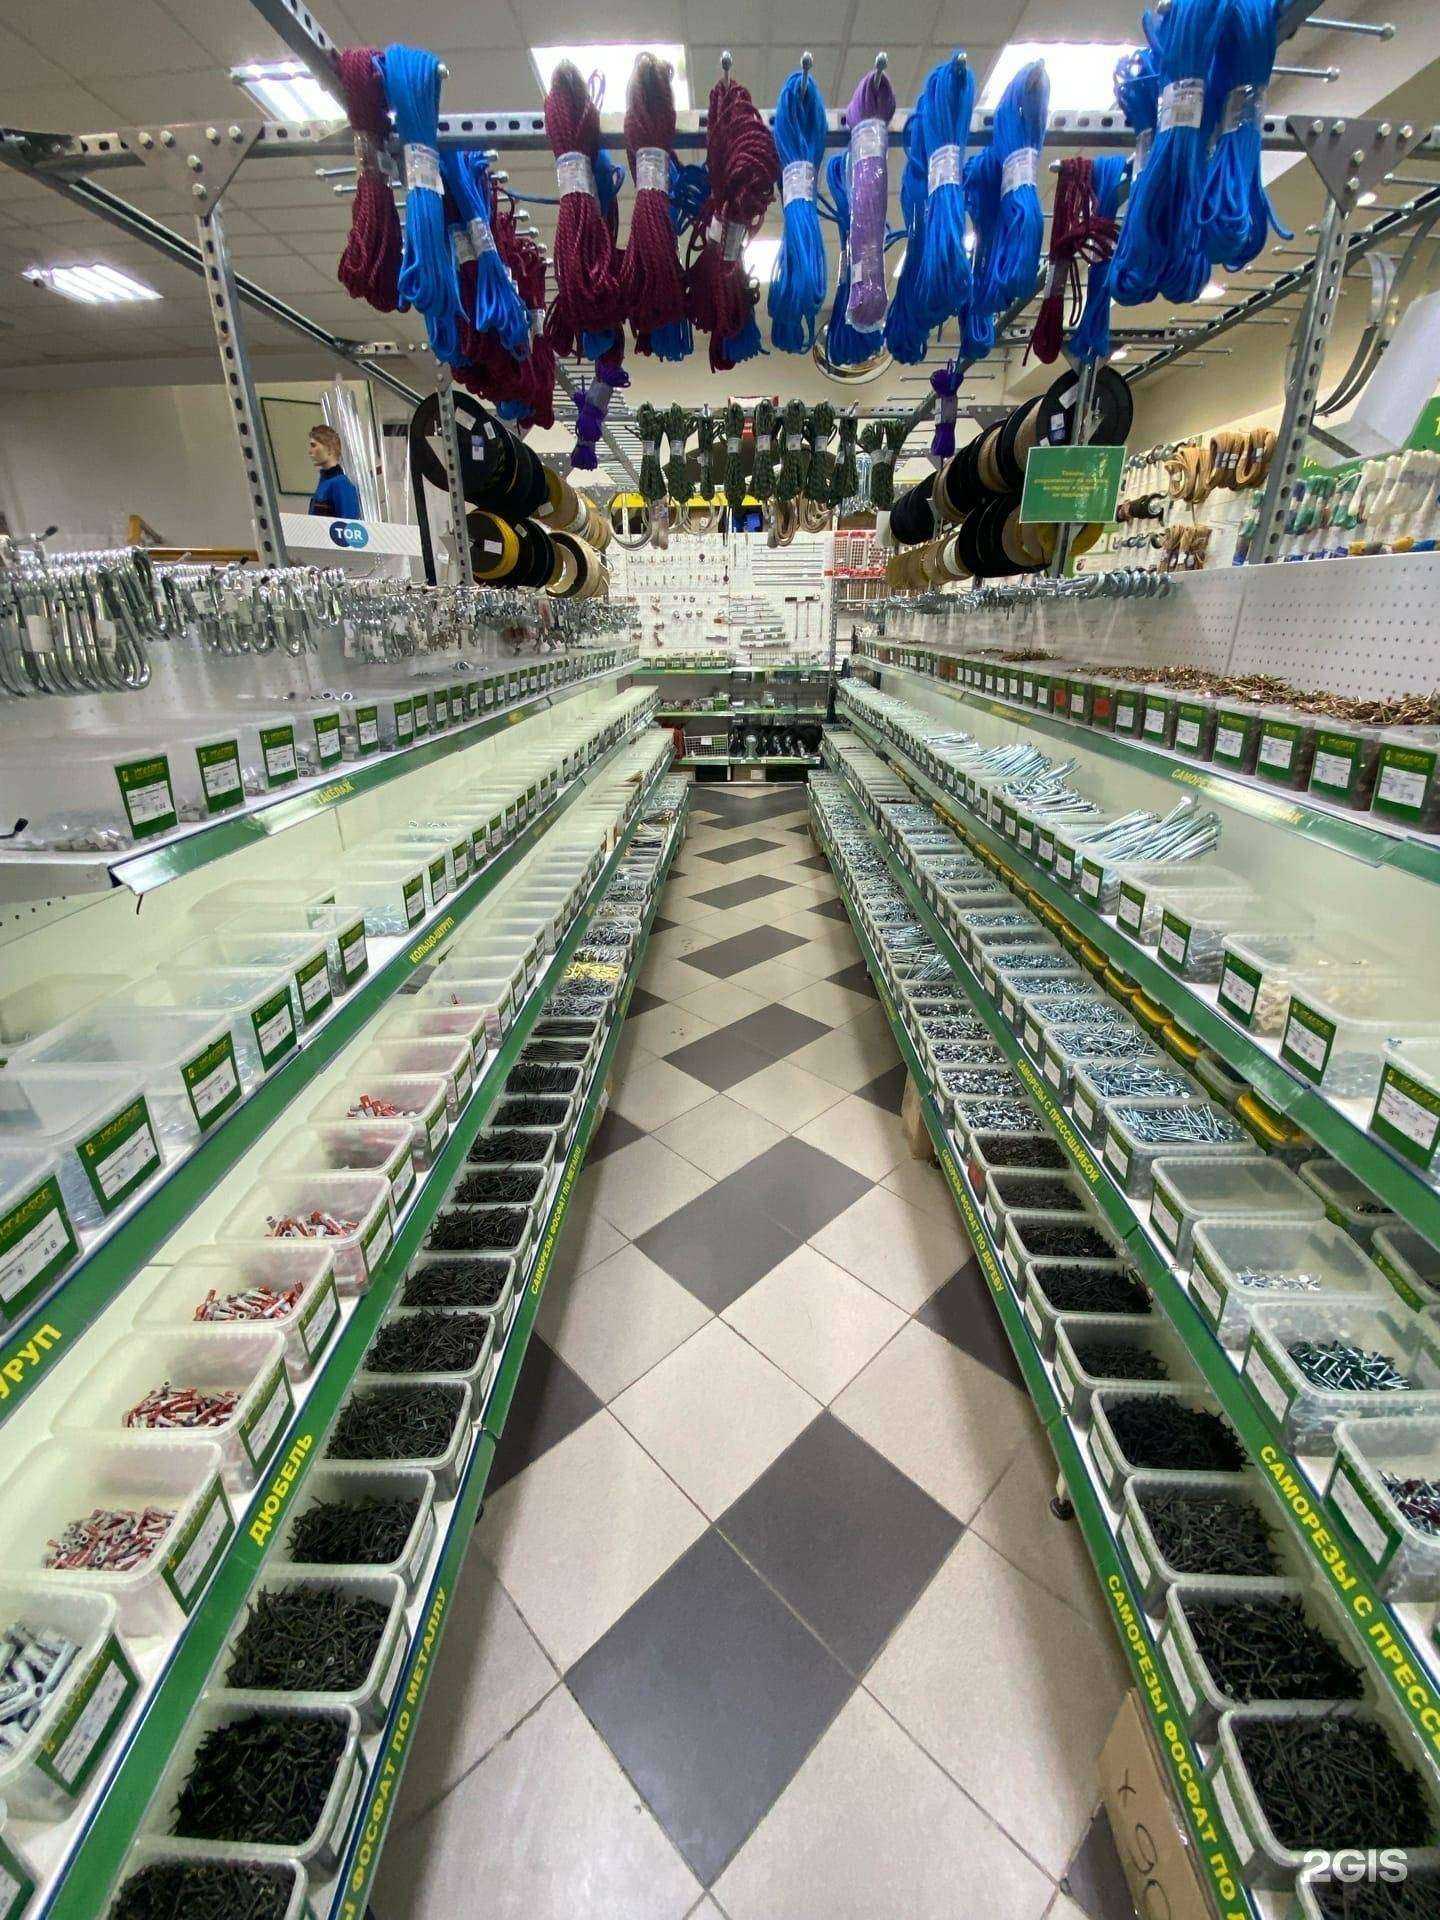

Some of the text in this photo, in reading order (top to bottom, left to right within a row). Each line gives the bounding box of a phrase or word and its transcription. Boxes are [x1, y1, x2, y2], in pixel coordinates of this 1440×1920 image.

[334, 527, 363, 541] TOR
[1016, 1059, 1100, 1183] САМОРЕЗЫ С ПРЕССШАЙБОЙ
[531, 1234, 554, 1295] САМОРЕЗЫ
[550, 1196, 568, 1234] ФОСФАТ
[562, 1180, 571, 1197] ПО
[941, 1149, 1005, 1292] САМОРЕЗЫ ФОСФАТ ПО ДЕРЕВУ
[249, 1434, 313, 1547] ДЮБЕЛЬ
[1260, 1446, 1440, 1752] САМОРЕЗЫ С ПРЕСС
[352, 1586, 446, 1893] ФОСФАТ ПО МЕТАЛЛУ
[1108, 1574, 1236, 1902] САМОРЕЗЫ ФОСФАТ ПО
